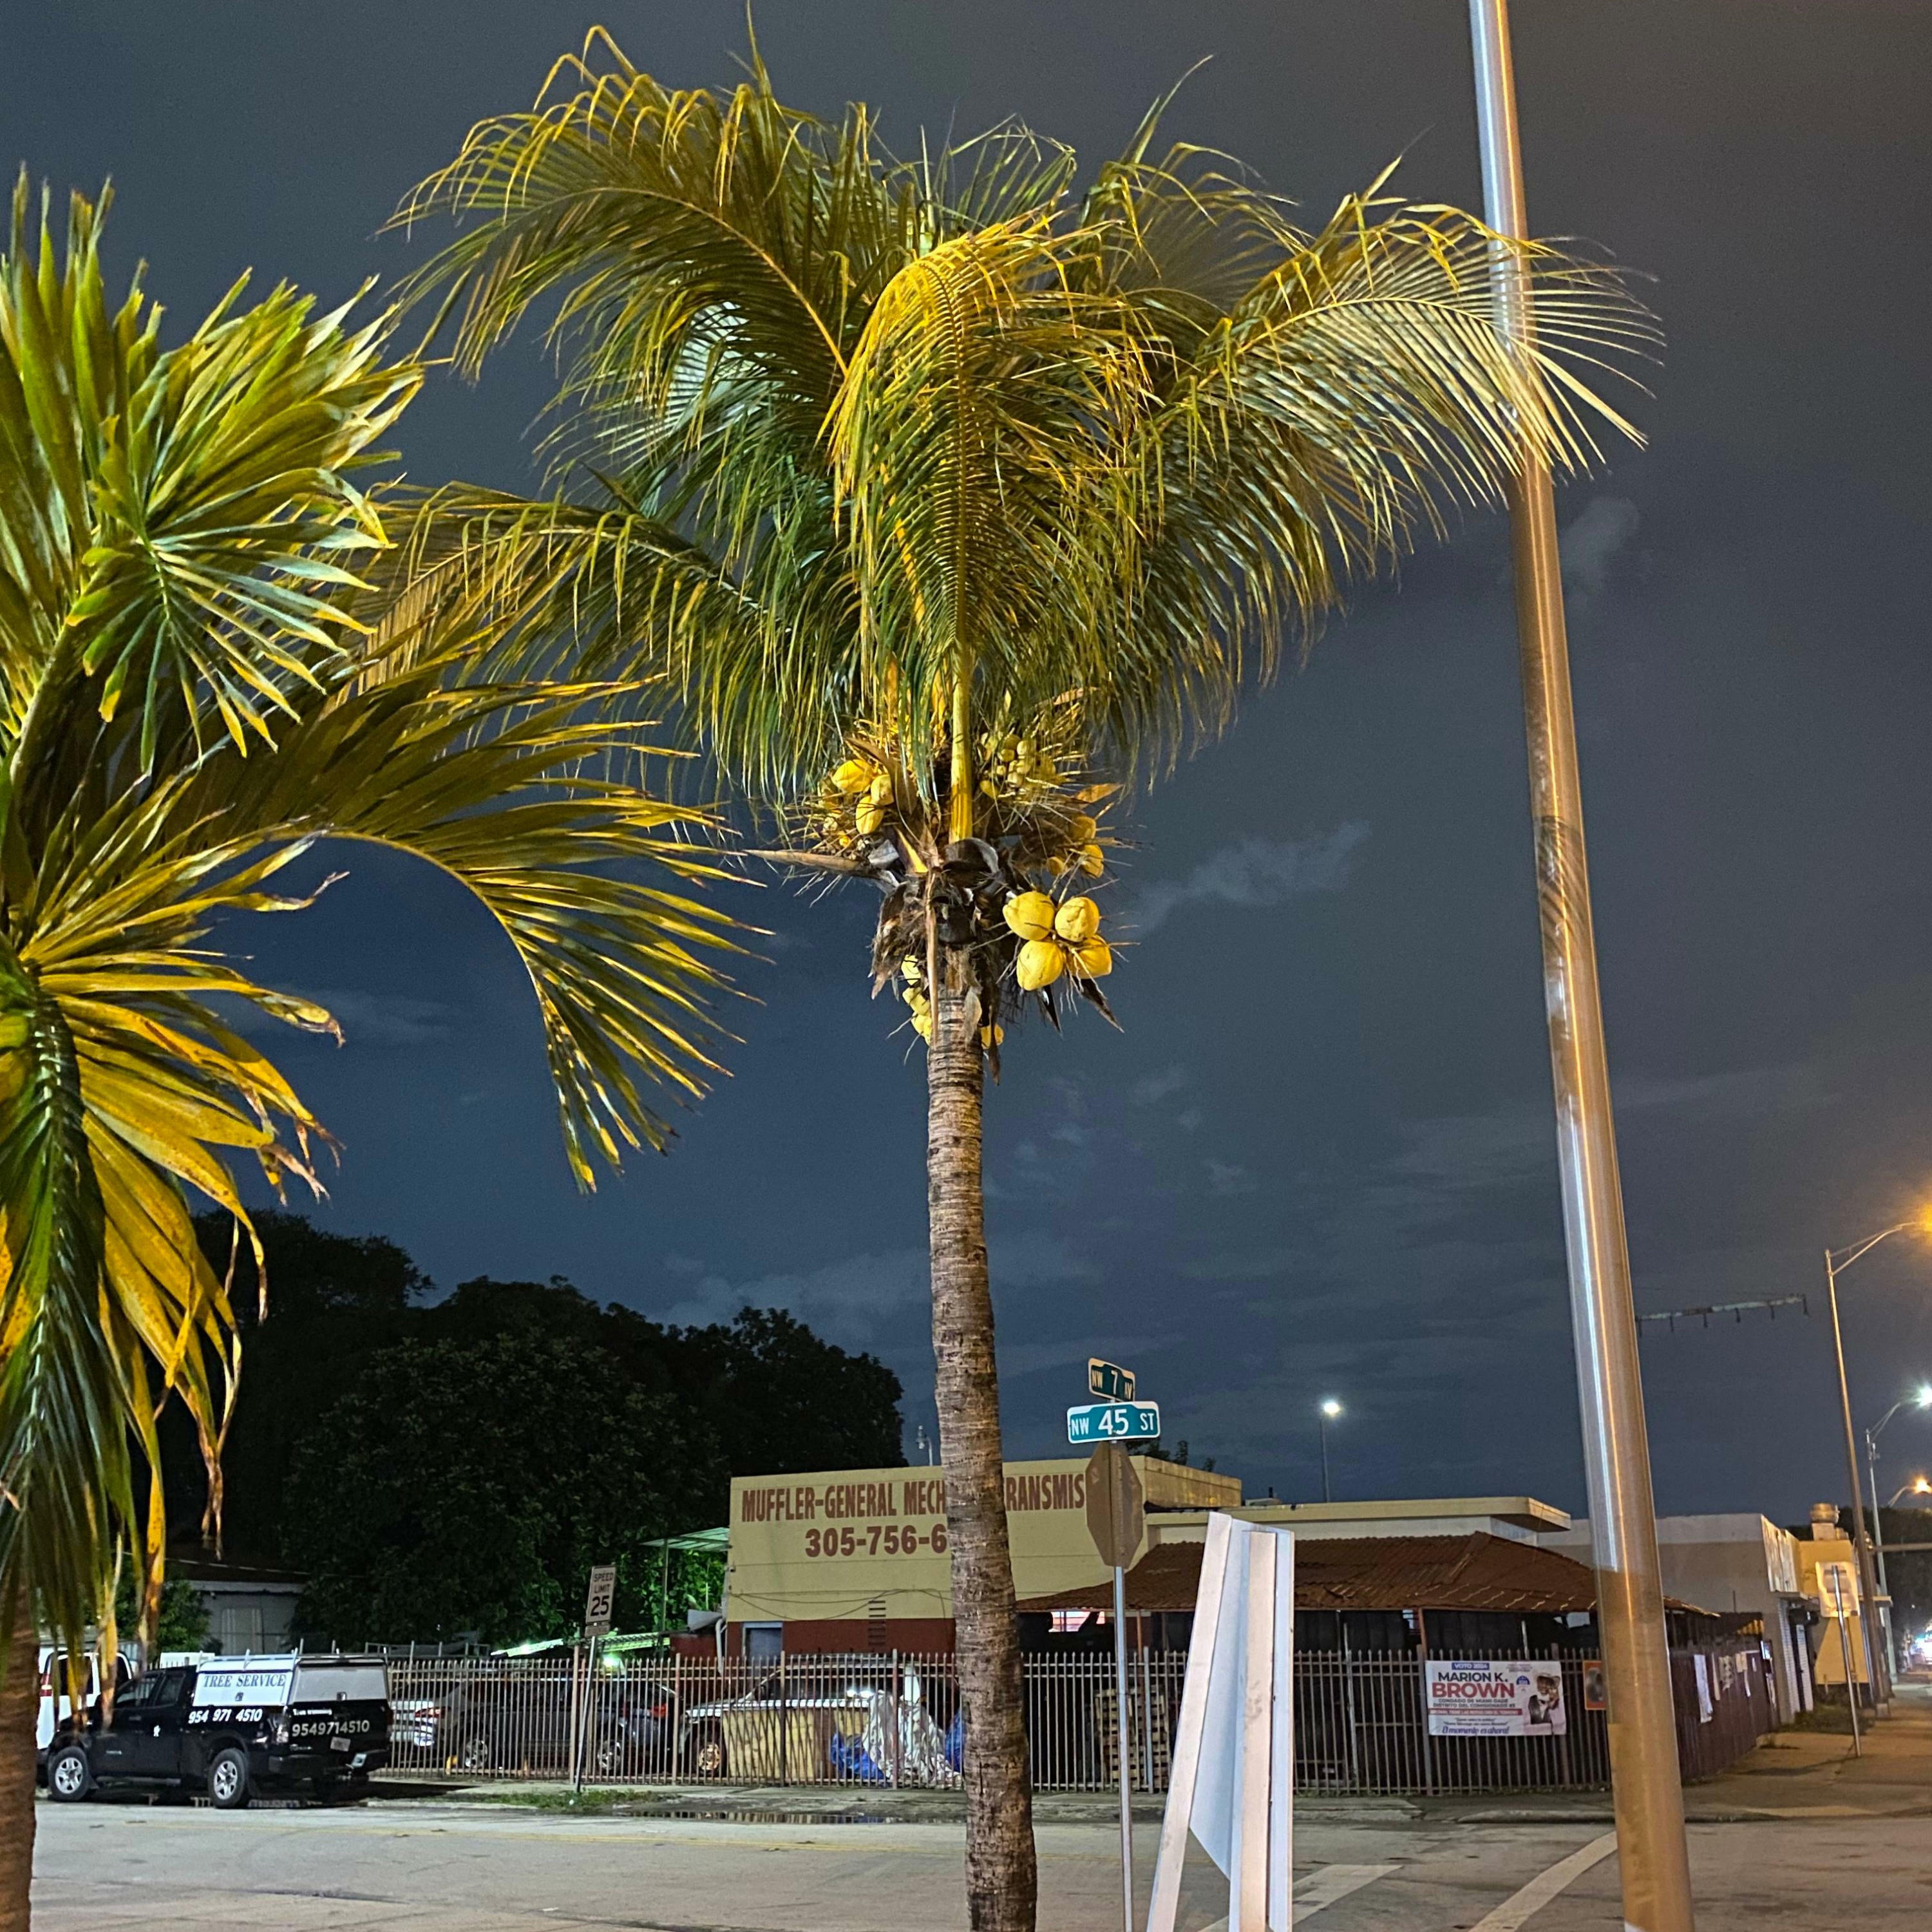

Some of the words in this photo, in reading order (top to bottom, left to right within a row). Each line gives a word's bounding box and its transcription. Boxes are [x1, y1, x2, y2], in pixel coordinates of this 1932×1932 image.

[1092, 1369, 1103, 1389] NW
[1111, 1370, 1118, 1395] 7
[1124, 1381, 1133, 1399] AV
[1070, 1417, 1090, 1436] NW
[1098, 1408, 1129, 1435] 45
[1139, 1413, 1155, 1431] ST
[742, 1482, 896, 1522] MUFFLER-GENERAL
[904, 1480, 945, 1516] MECH
[1005, 1473, 1085, 1511] RANSMIS
[805, 1524, 947, 1558] 305-756-6
[594, 1572, 613, 1582] SPEED
[594, 1584, 611, 1593] LIMIT
[591, 1595, 610, 1616] 25
[204, 1675, 232, 1687] TREE
[236, 1674, 287, 1687] SERVICE
[1438, 1672, 1492, 1682] MARION
[1494, 1672, 1508, 1682] K.
[1432, 1682, 1515, 1698] BROWN
[188, 1710, 209, 1725] 954
[213, 1708, 232, 1722] 971
[236, 1708, 263, 1722] 4510
[292, 1719, 370, 1738] 9549714510
